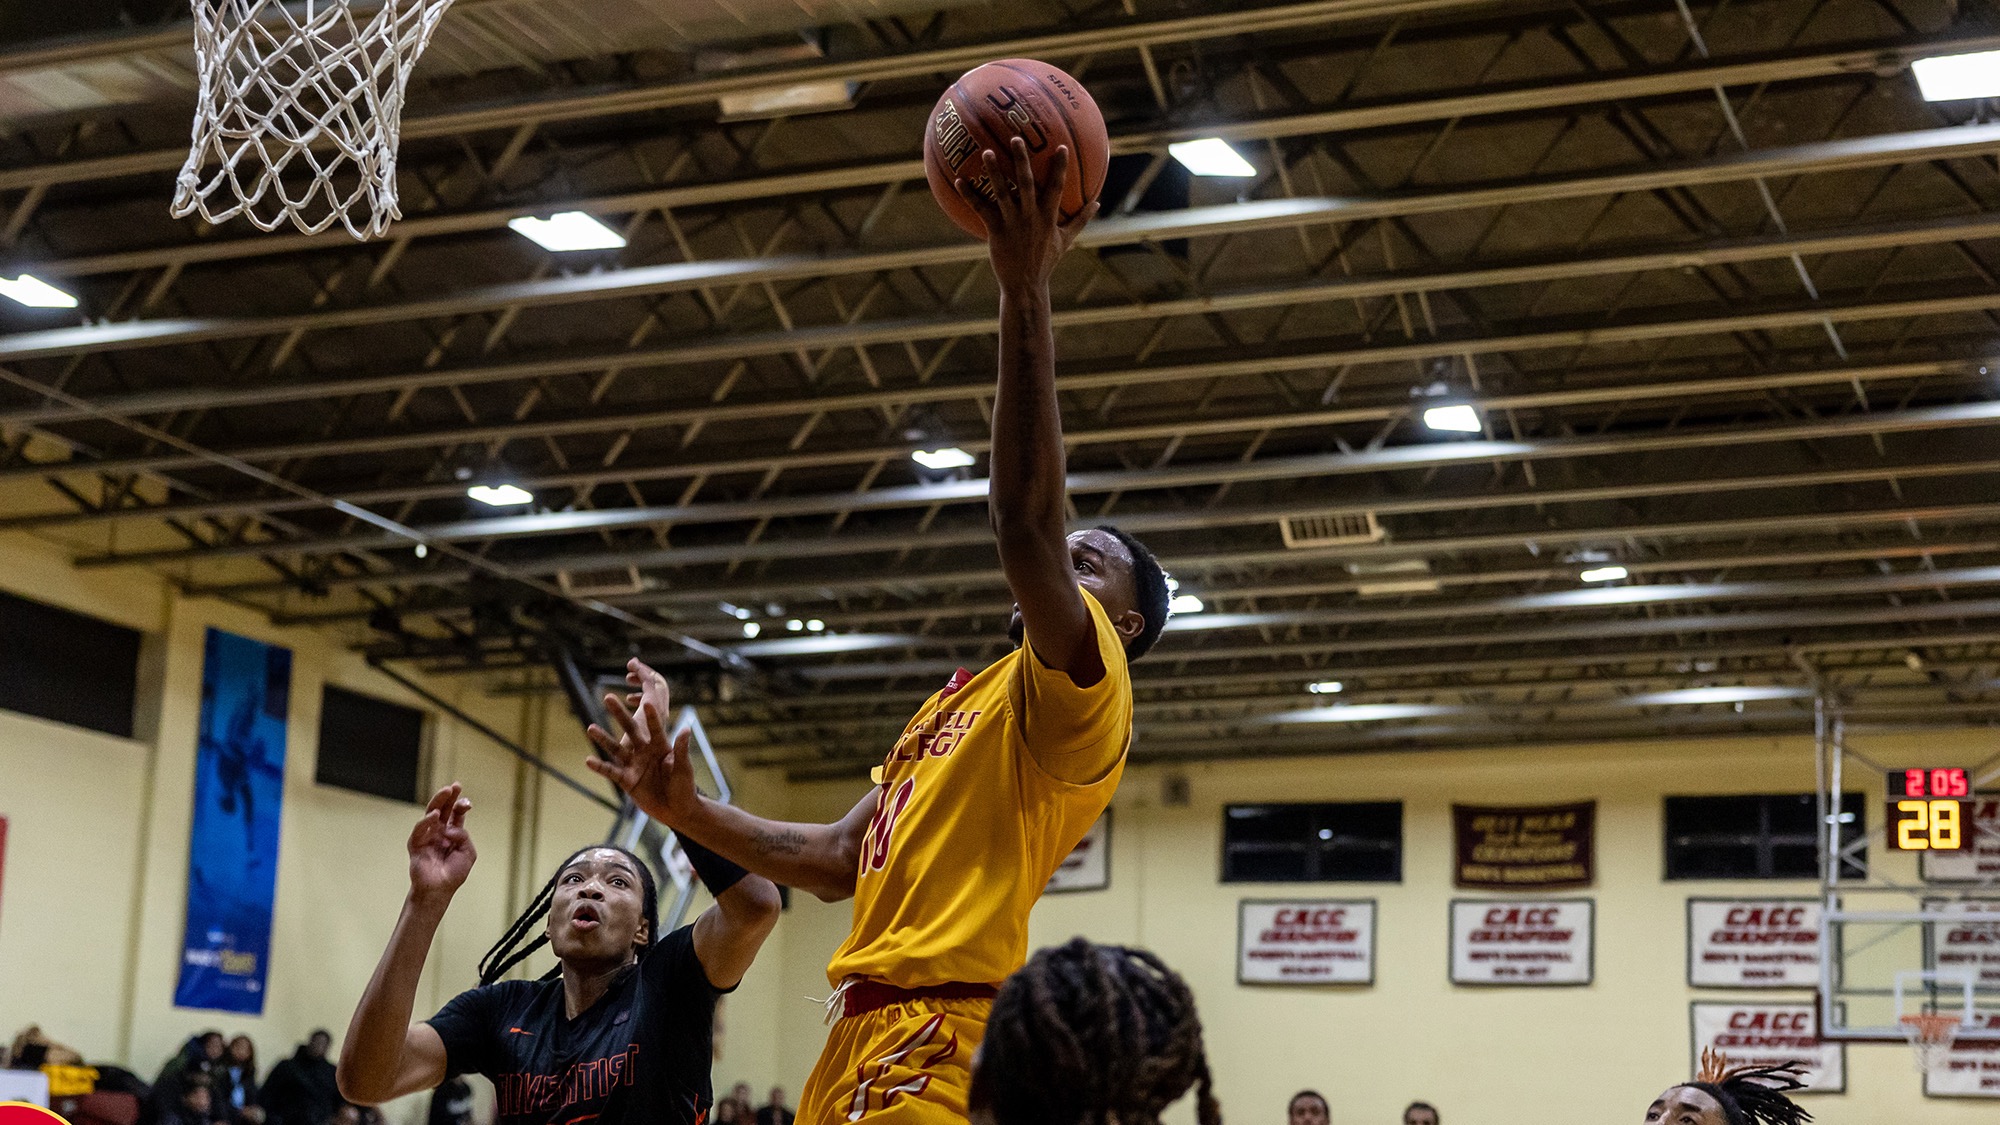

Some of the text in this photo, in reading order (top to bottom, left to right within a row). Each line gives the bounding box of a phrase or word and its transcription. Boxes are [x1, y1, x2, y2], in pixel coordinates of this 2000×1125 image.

[936, 98, 979, 175] ROCK
[1898, 799, 1961, 851] 28
[1274, 909, 1346, 926] CACC
[1484, 908, 1560, 926] CACC
[1725, 907, 1807, 926] CACC
[1728, 1011, 1809, 1030] CACC
